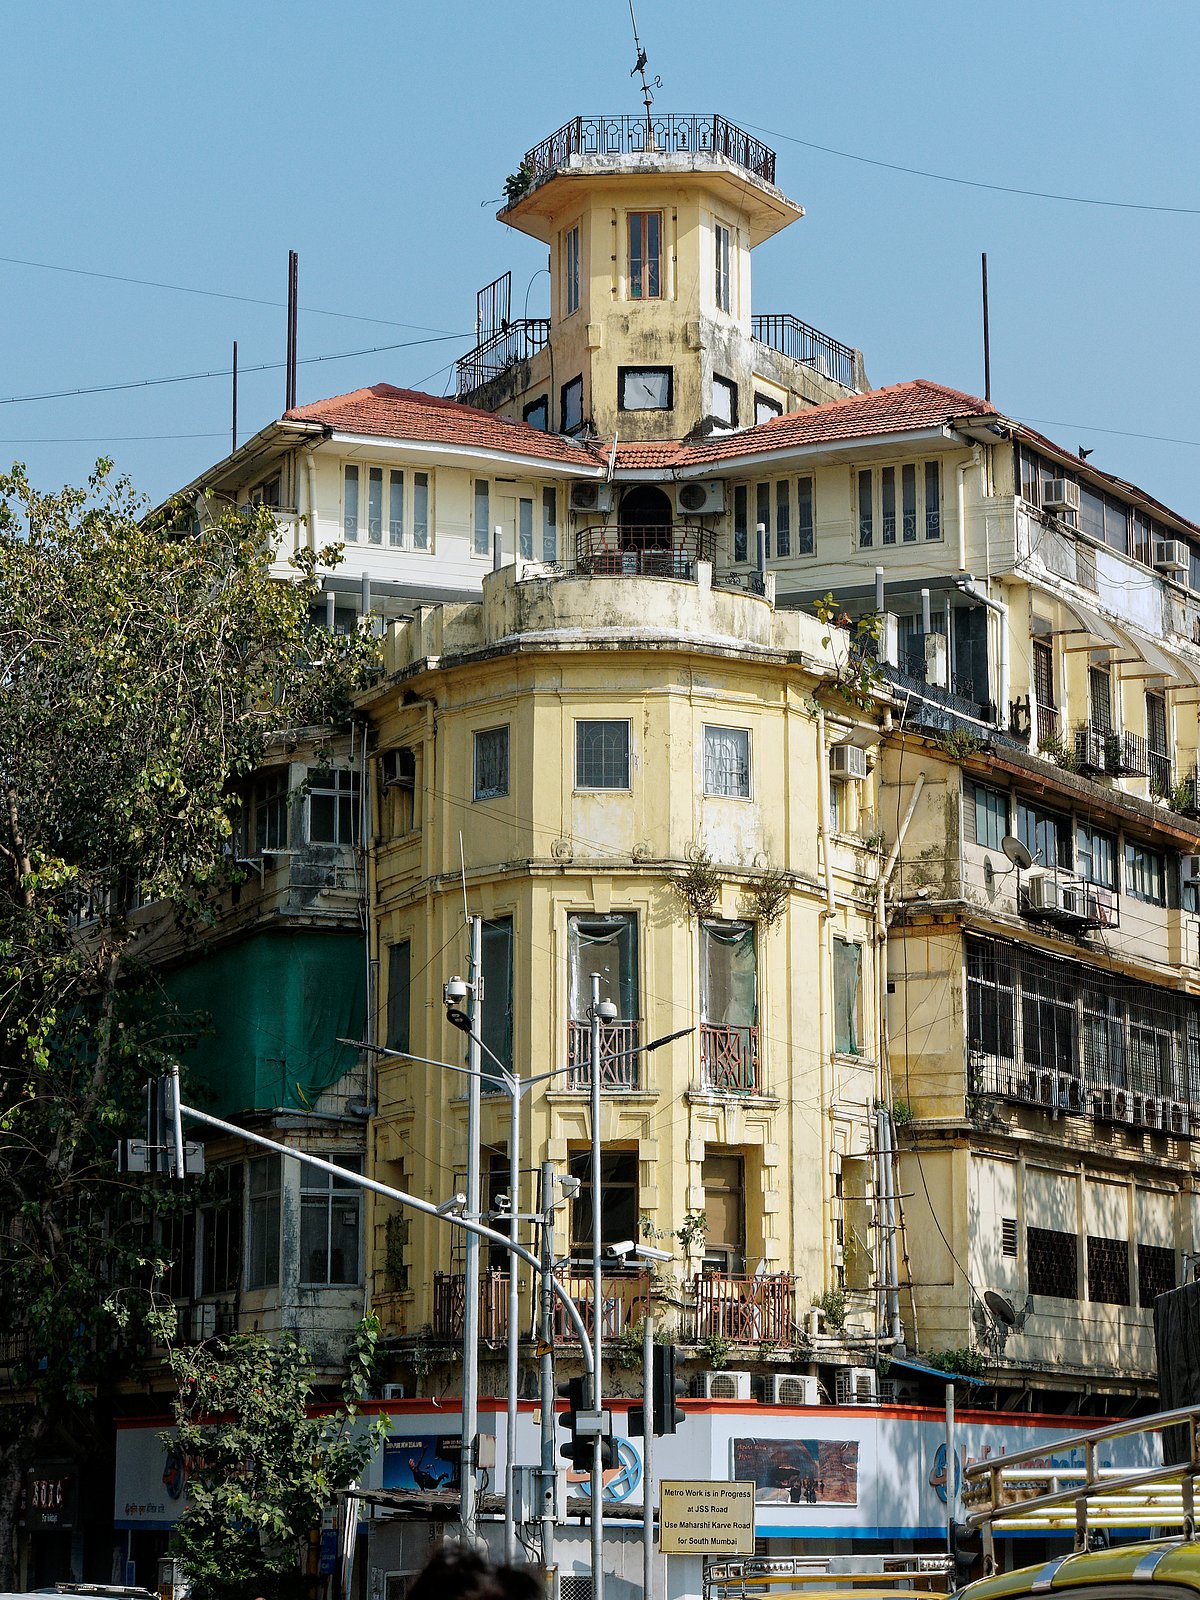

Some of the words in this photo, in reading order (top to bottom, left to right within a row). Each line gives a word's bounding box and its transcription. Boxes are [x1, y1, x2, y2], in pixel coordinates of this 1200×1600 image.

[685, 1489, 704, 1497] Work
[705, 1489, 711, 1497] is
[720, 1490, 751, 1499] Progress
[695, 1505, 709, 1513] JSS
